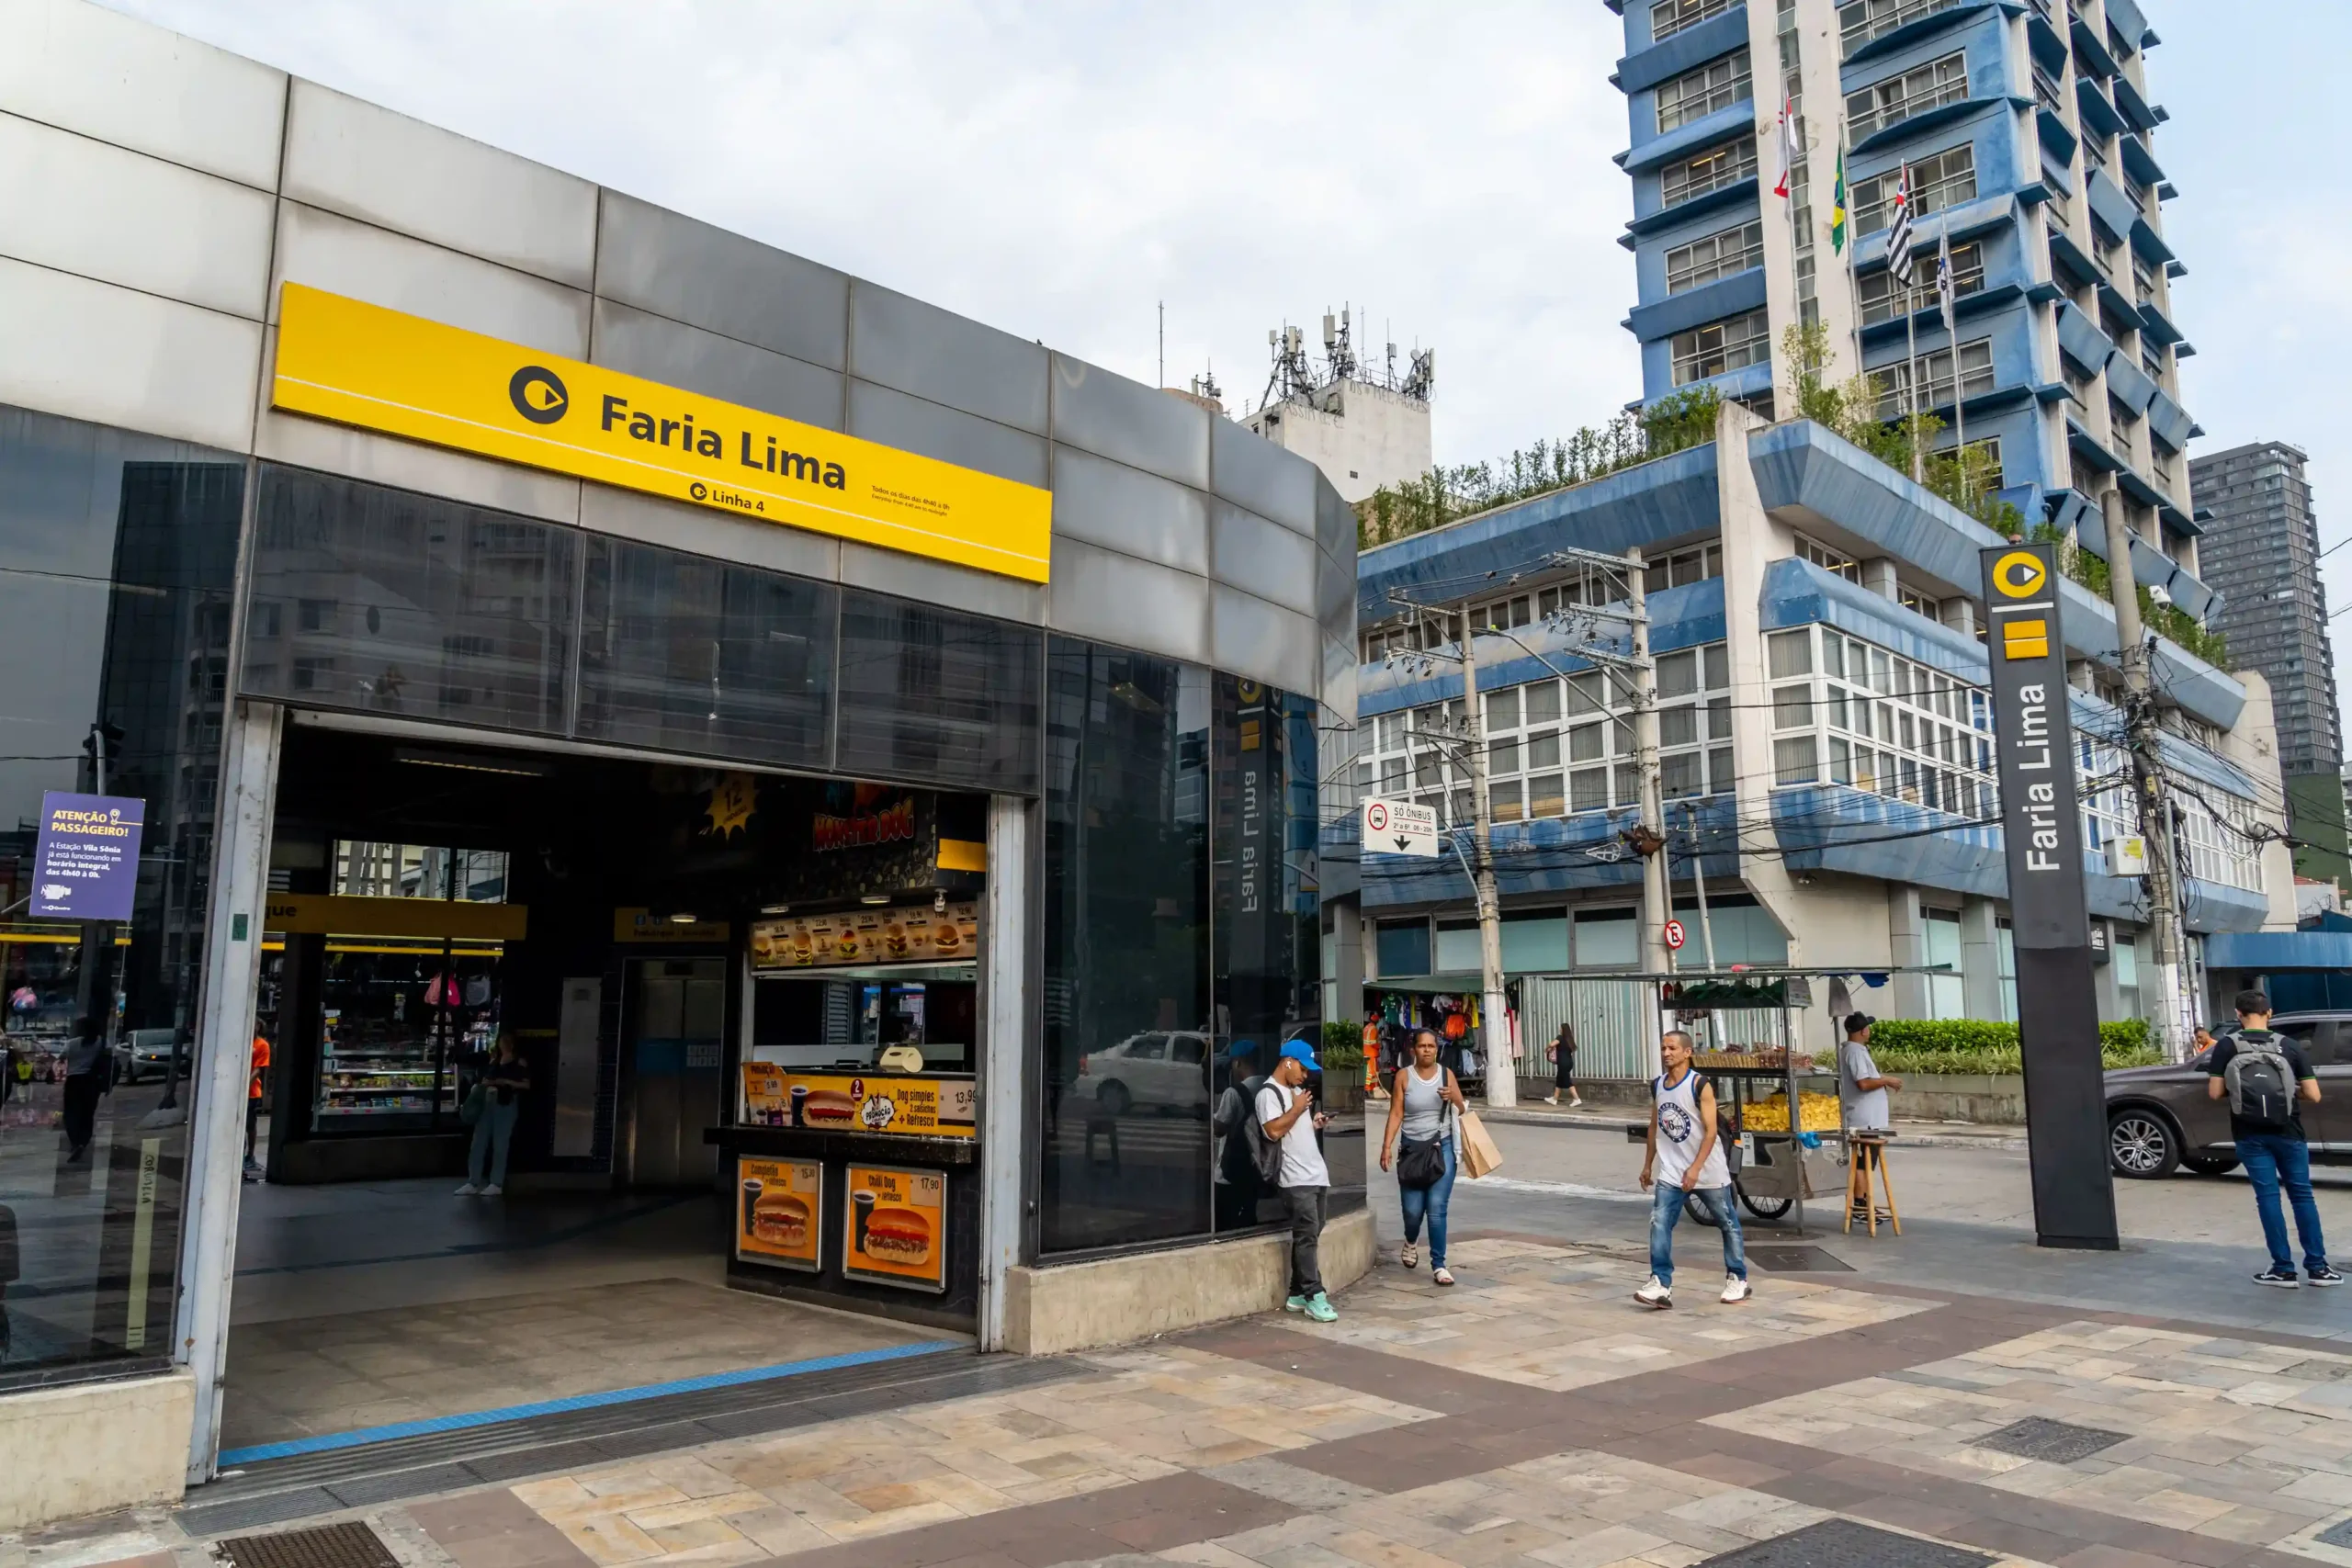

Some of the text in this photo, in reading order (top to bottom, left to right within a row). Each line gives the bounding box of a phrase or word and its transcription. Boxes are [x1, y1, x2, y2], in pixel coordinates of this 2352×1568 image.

[601, 393, 846, 491] Faria Lima
[713, 490, 765, 513] Linha 4
[871, 485, 889, 495] Todos
[898, 492, 910, 501] dias
[910, 495, 922, 503] das
[2016, 683, 2061, 871] Faria Lima
[52, 810, 107, 824] ATENÇÃO
[878, 795, 914, 843] DOG
[1394, 805, 1431, 821] SÓ ÔNIBUS
[51, 822, 129, 837] PASSAGEIRO!
[56, 842, 82, 852] Estação
[83, 844, 98, 852] Vila
[99, 845, 121, 853] Sônia
[47, 851, 54, 859] já
[55, 851, 70, 859] está
[71, 852, 110, 862] funcionando
[46, 859, 110, 871] horário integral,
[45, 868, 61, 876] das
[61, 869, 81, 877] 4h40
[81, 870, 87, 878] à
[854, 1079, 861, 1093] 2
[897, 1089, 909, 1104] Dog
[910, 1089, 935, 1105] simples
[906, 1113, 935, 1127] Refresco
[883, 1176, 896, 1192] Dog
